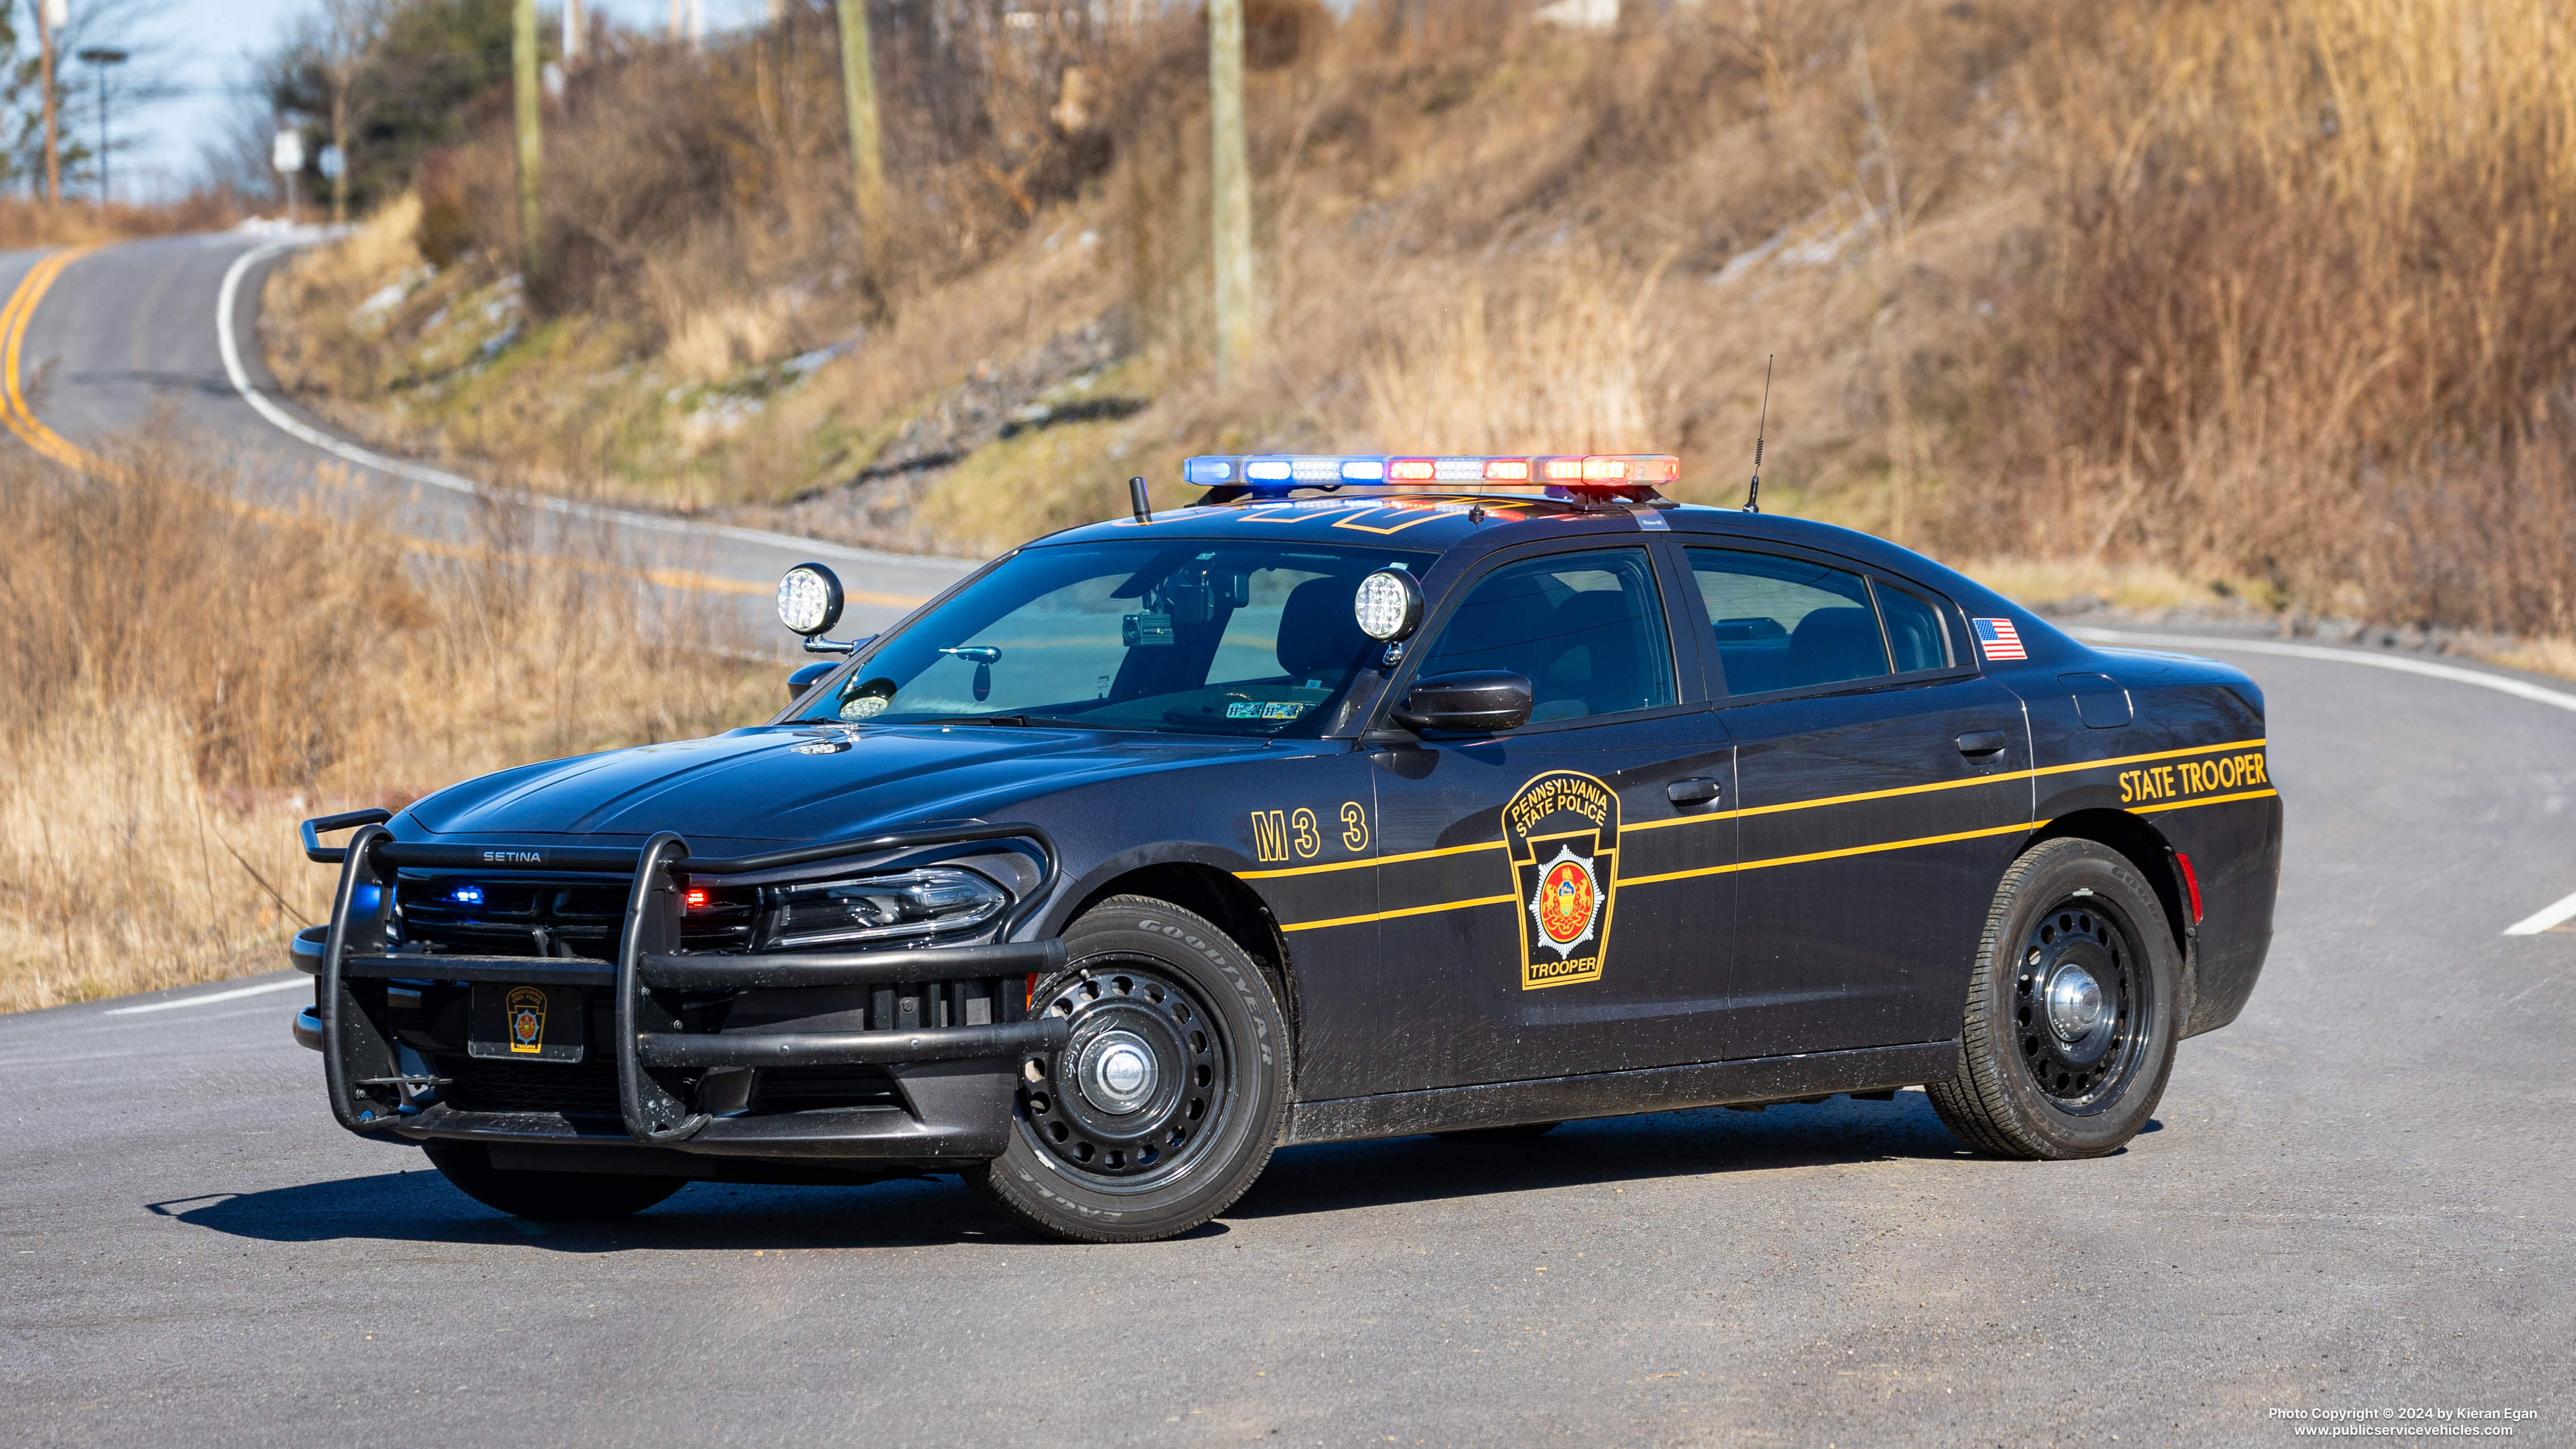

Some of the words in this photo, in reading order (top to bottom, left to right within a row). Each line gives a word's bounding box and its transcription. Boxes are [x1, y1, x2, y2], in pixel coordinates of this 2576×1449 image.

[2118, 766, 2176, 803] STATE
[2178, 752, 2268, 795] TROOPER
[1511, 779, 1607, 822] PENNSYLVANIA
[1516, 797, 1555, 838] STATE
[1557, 795, 1607, 827] POLICE
[484, 851, 541, 862] SETINA
[1530, 957, 1596, 978] TROOPER
[1138, 919, 1273, 1066] GOODYEAR
[1018, 1167, 1122, 1222] EAGLE
